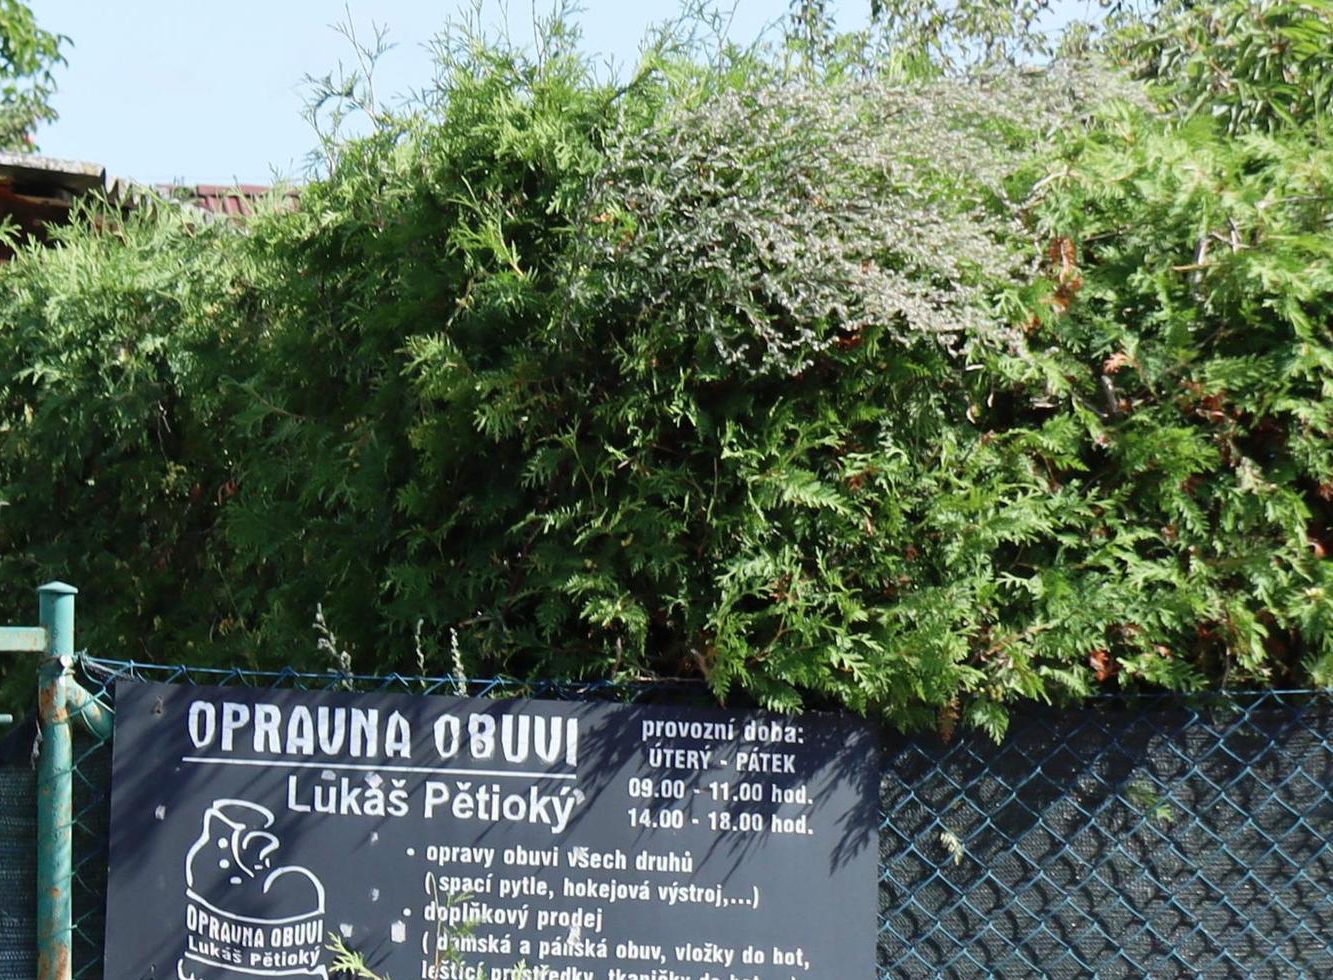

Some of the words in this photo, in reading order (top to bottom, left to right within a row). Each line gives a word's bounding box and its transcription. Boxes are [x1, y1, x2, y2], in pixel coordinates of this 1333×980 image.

[188, 700, 411, 758] OPRAVNA
[433, 713, 578, 767] OBUVI
[642, 717, 735, 742] provozní
[744, 719, 804, 744] doba:
[649, 742, 712, 770] ÚTERÝ
[736, 747, 796, 774] PÁTEK
[288, 775, 409, 817] Lukáš
[424, 781, 577, 834] Pětioký
[628, 777, 685, 799] 09.00
[709, 781, 763, 802] 11.00
[771, 784, 814, 805] hod.
[628, 807, 684, 829] 14.00
[708, 811, 763, 832] 18.00
[771, 815, 814, 835] hod.
[426, 845, 495, 868] opravy
[503, 845, 559, 867] obuvi
[567, 847, 627, 870] všech
[635, 851, 693, 873] druhů
[499, 876, 555, 900] pytle,
[563, 878, 650, 903] hokejová
[186, 903, 264, 948] OPRAVNA
[271, 919, 323, 948] OBUVI
[537, 907, 603, 933] prodej
[519, 939, 531, 954] a
[616, 940, 667, 964] obuv,
[675, 943, 735, 968] vložky
[743, 946, 765, 964] do
[773, 947, 810, 970] bot,
